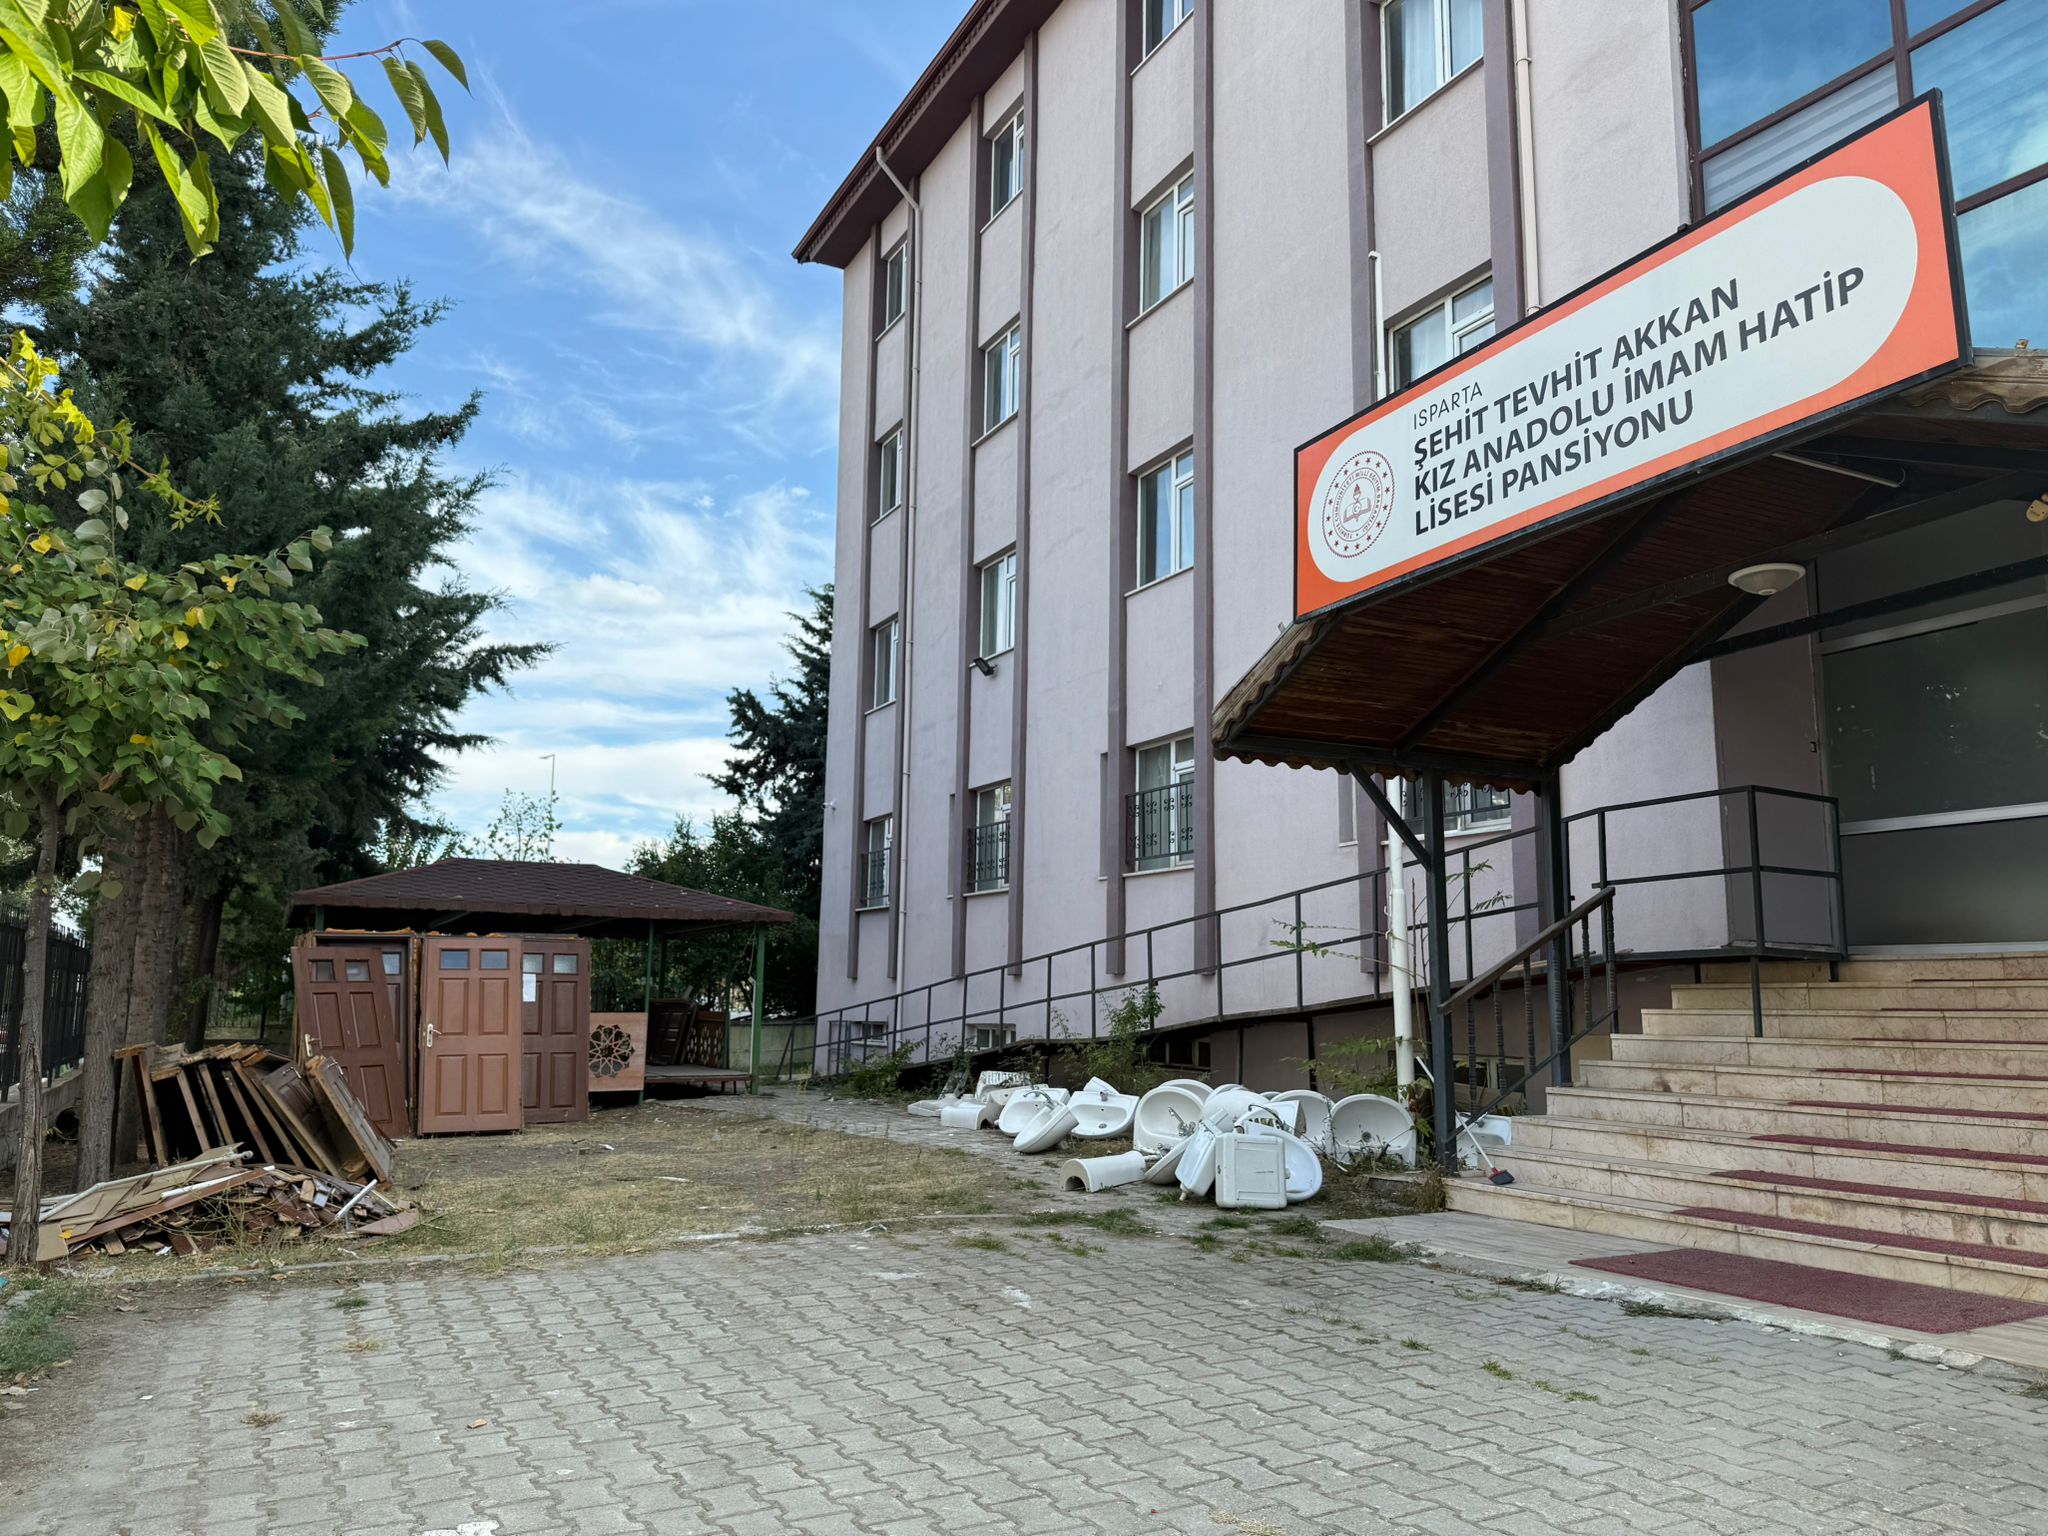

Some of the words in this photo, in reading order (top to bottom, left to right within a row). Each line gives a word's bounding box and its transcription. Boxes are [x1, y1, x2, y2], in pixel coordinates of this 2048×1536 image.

[1414, 405, 1489, 471] ŞEHİT
[1494, 347, 1603, 424] TEVHİT
[1612, 278, 1739, 370] AKKAN
[1414, 382, 1483, 430] ISPARTA
[1415, 459, 1456, 500] KIZ
[1463, 383, 1614, 479] ANADOLU
[1625, 330, 1728, 404] İMAM
[1739, 267, 1864, 352] HATİP
[1416, 472, 1493, 536] LİSESİ
[1502, 390, 1694, 499] PANSİYONU
